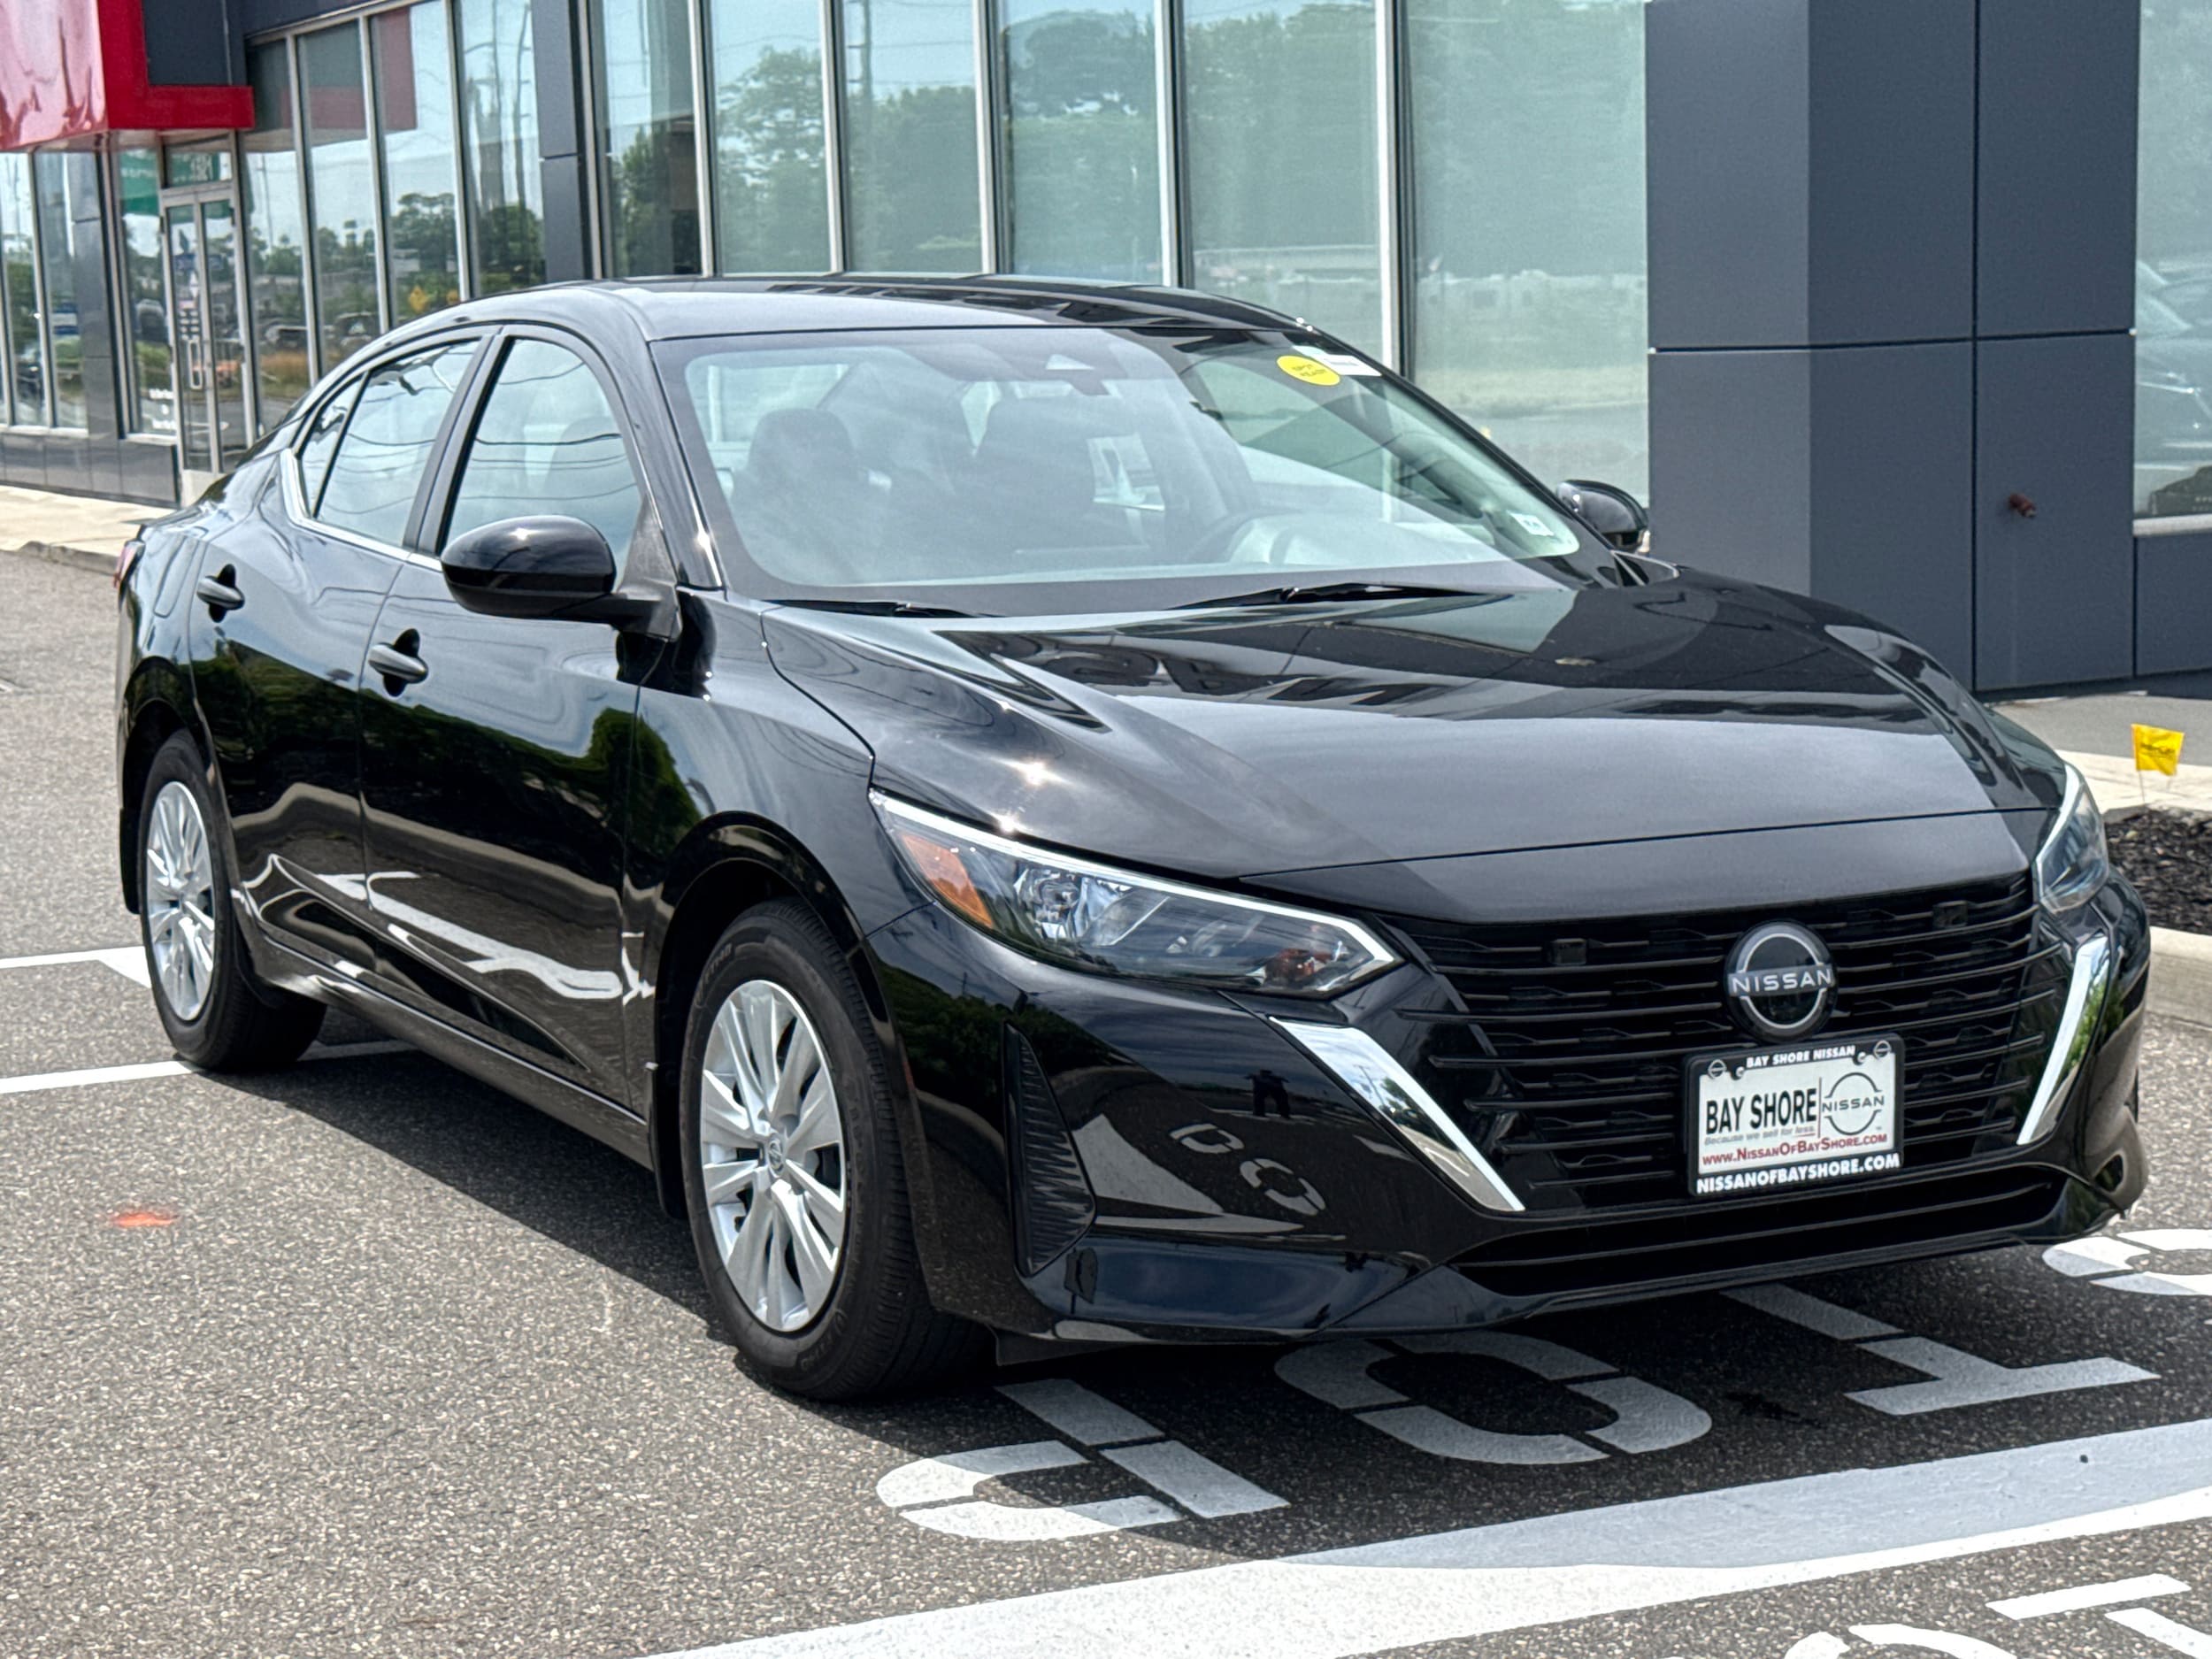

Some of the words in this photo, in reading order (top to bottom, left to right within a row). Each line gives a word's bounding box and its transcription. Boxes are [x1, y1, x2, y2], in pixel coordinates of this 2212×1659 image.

[1732, 969, 1832, 993] NISSAN
[1746, 1055, 1769, 1068] BAY
[1772, 1048, 1810, 1065] SHORE
[1813, 1045, 1855, 1060] NISSAN
[1706, 1096, 1745, 1135] BAY
[1749, 1087, 1817, 1130] SHORE
[1821, 1095, 1886, 1113] NISSAN
[1696, 1153, 1901, 1194] NISSANOFBAYSHORE.COM
